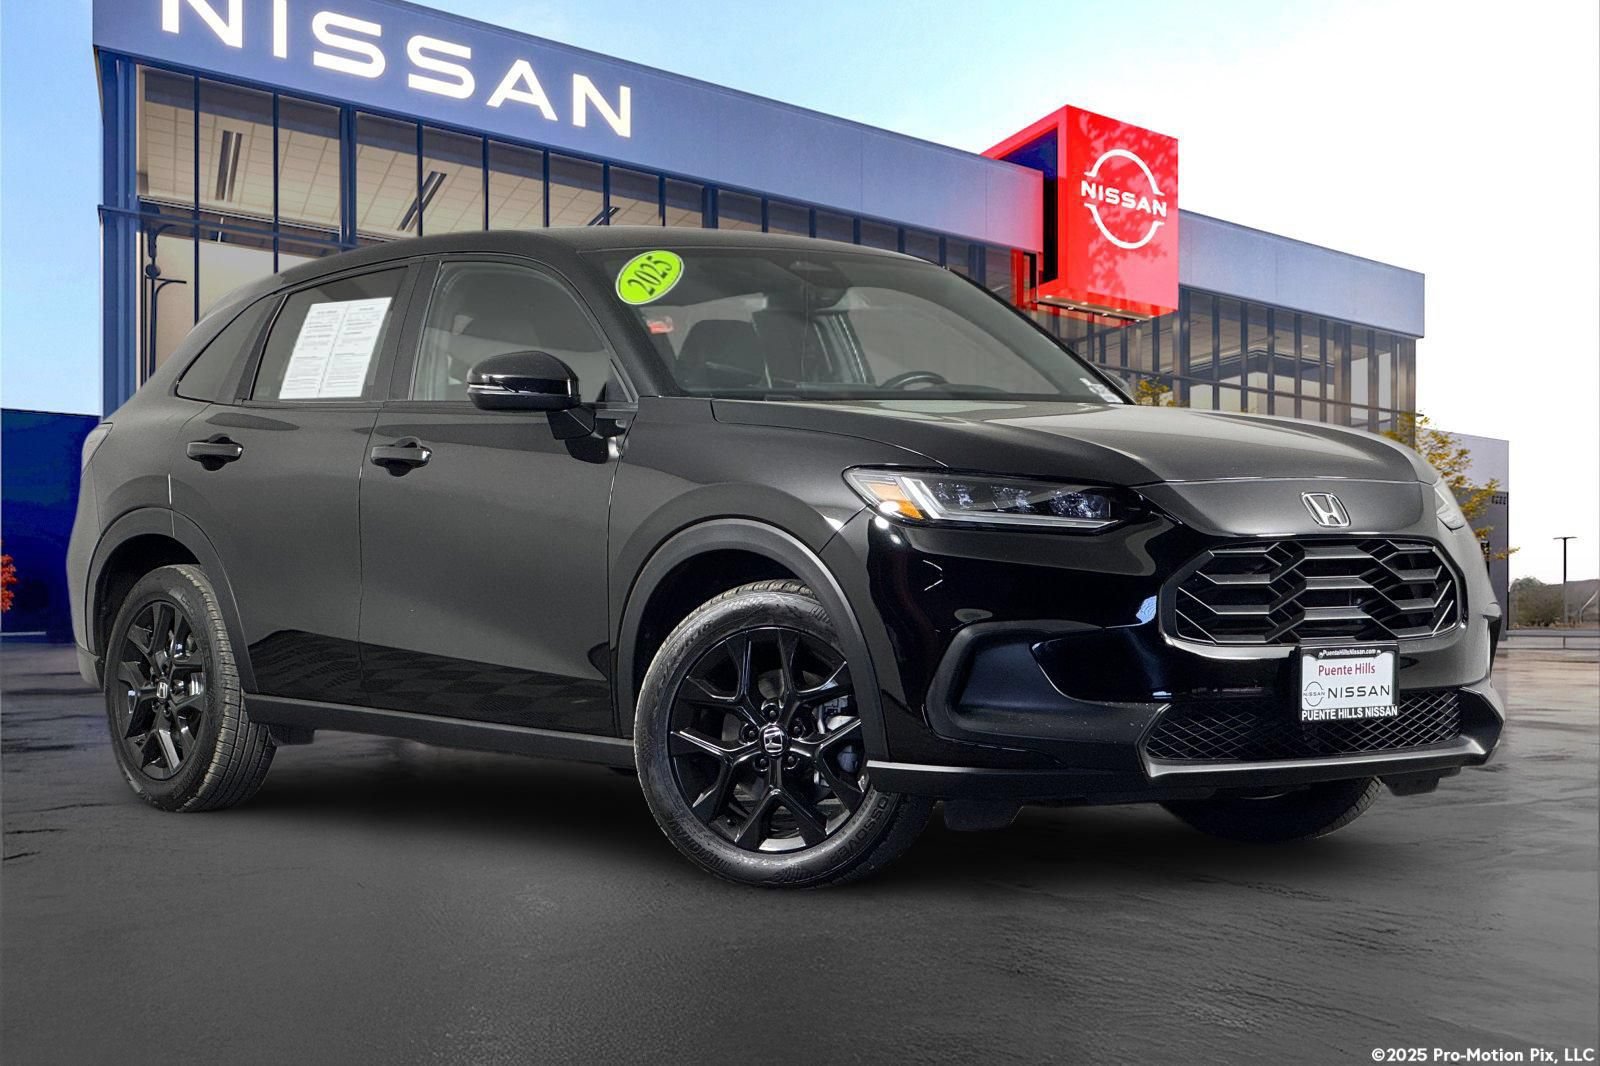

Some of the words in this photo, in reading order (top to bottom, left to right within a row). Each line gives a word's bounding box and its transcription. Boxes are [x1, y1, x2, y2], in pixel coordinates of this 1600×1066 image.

[161, 0, 631, 138] NISSAN
[1081, 180, 1167, 217] NISSAN
[627, 255, 673, 296] 2025
[1318, 664, 1353, 676] Puente
[1354, 662, 1376, 675] Hills
[1327, 685, 1390, 699] NISSAN
[1301, 709, 1337, 721] PUENTE
[1338, 707, 1363, 719] HILLS
[1365, 705, 1398, 718] NISSAN
